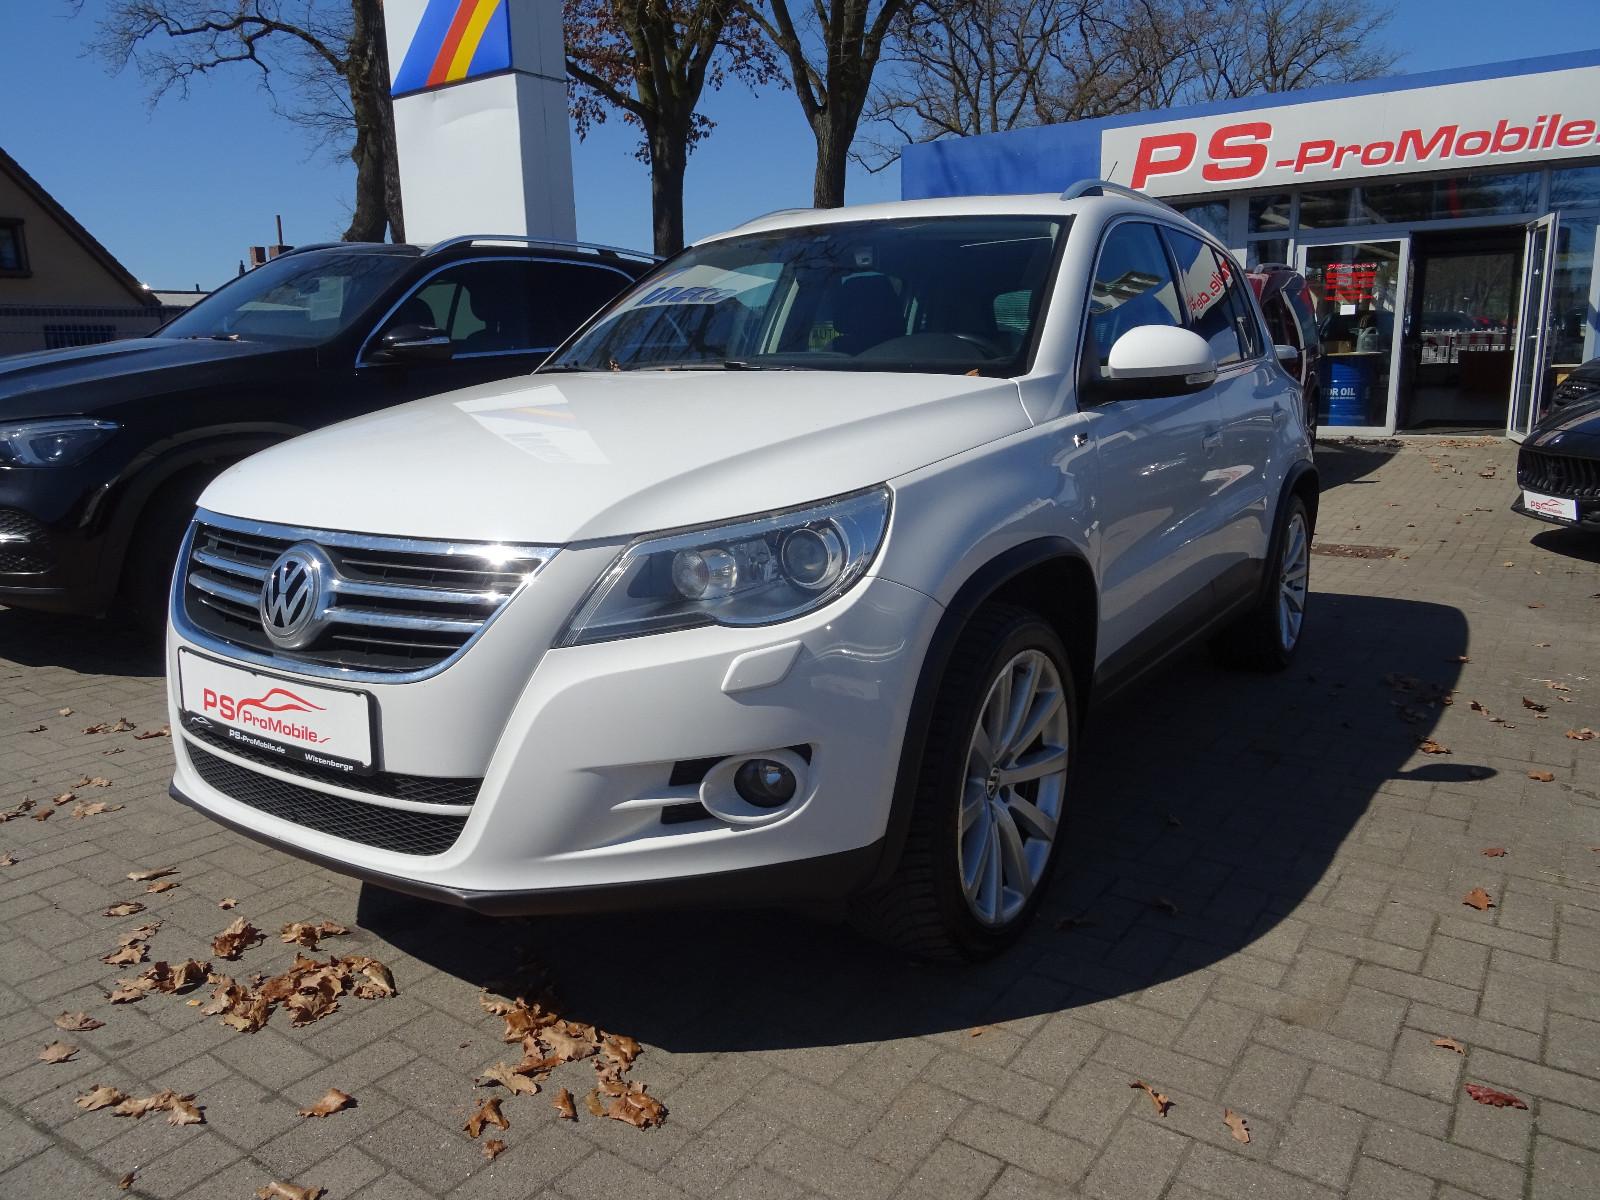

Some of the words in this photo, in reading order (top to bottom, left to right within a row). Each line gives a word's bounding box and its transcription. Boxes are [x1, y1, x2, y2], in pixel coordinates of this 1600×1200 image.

[1340, 387, 1356, 396] OIL
[263, 556, 316, 632] VW
[203, 688, 236, 721] PS
[243, 708, 318, 742] ProMobile
[229, 728, 286, 754] PS-ProMobile.de
[304, 752, 354, 772] Wittenberge
